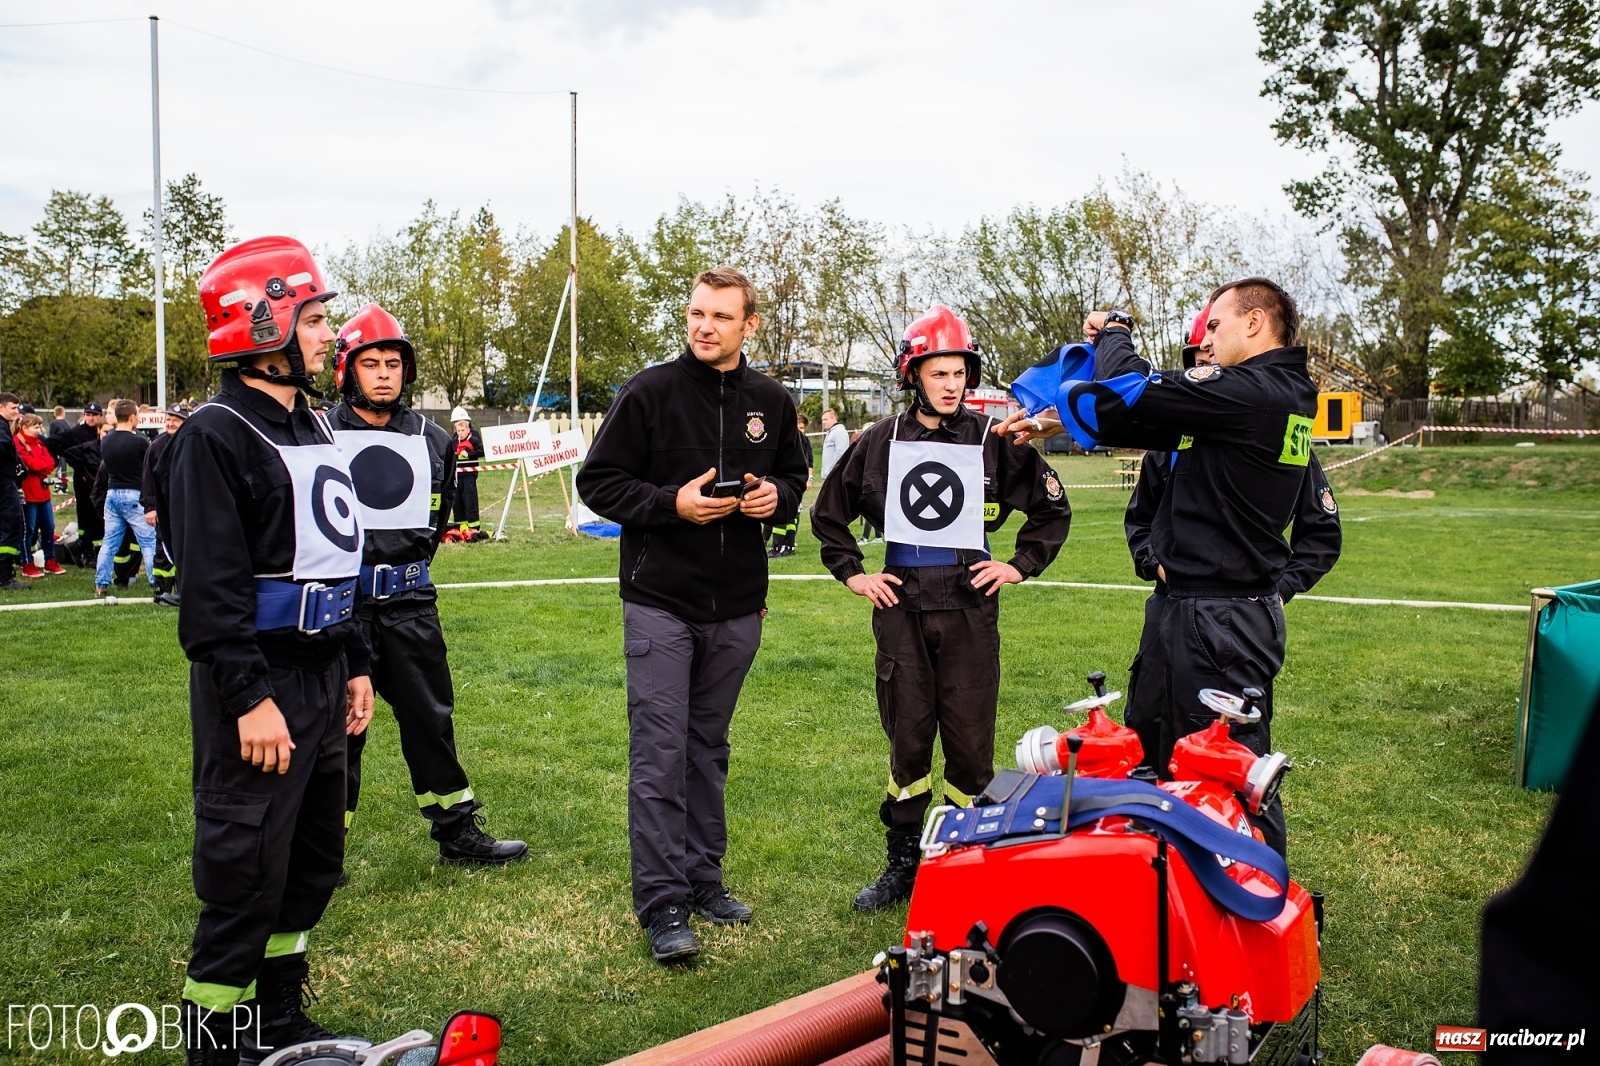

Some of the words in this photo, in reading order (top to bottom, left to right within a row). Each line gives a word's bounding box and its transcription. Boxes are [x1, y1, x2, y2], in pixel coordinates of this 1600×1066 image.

[138, 416, 146, 424] SP
[509, 429, 527, 440] OSP
[492, 438, 540, 455] SŁAWIKÓW
[552, 439, 561, 450] SP
[533, 447, 578, 469] SŁAWIKÓW
